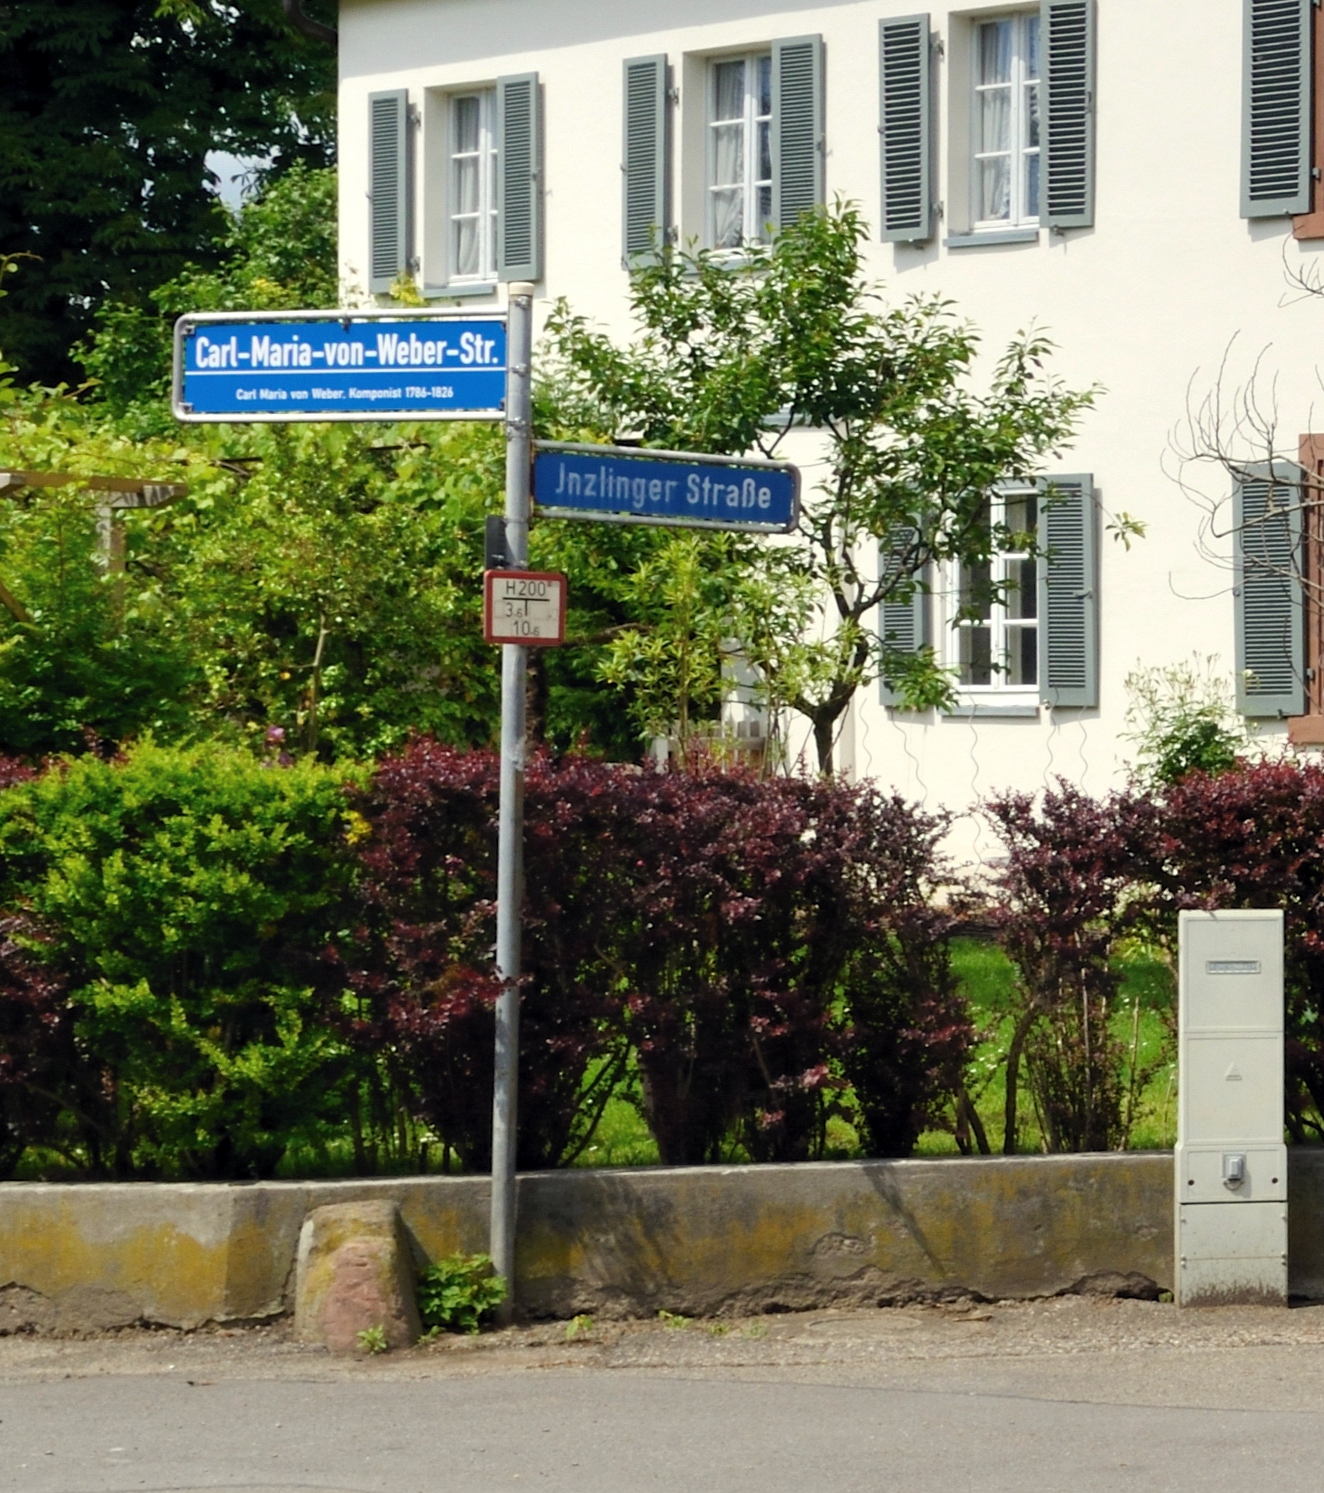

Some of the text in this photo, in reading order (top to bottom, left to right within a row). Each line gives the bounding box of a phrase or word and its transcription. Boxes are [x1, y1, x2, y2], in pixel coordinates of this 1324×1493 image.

[195, 331, 499, 368] Carl-Maria-von-Weber-Str.
[235, 388, 257, 400] Carl
[259, 388, 287, 400] Maria
[290, 390, 308, 399] von
[348, 387, 402, 401] Komponist
[405, 386, 454, 398] 1786-1826
[686, 473, 772, 509] Straße
